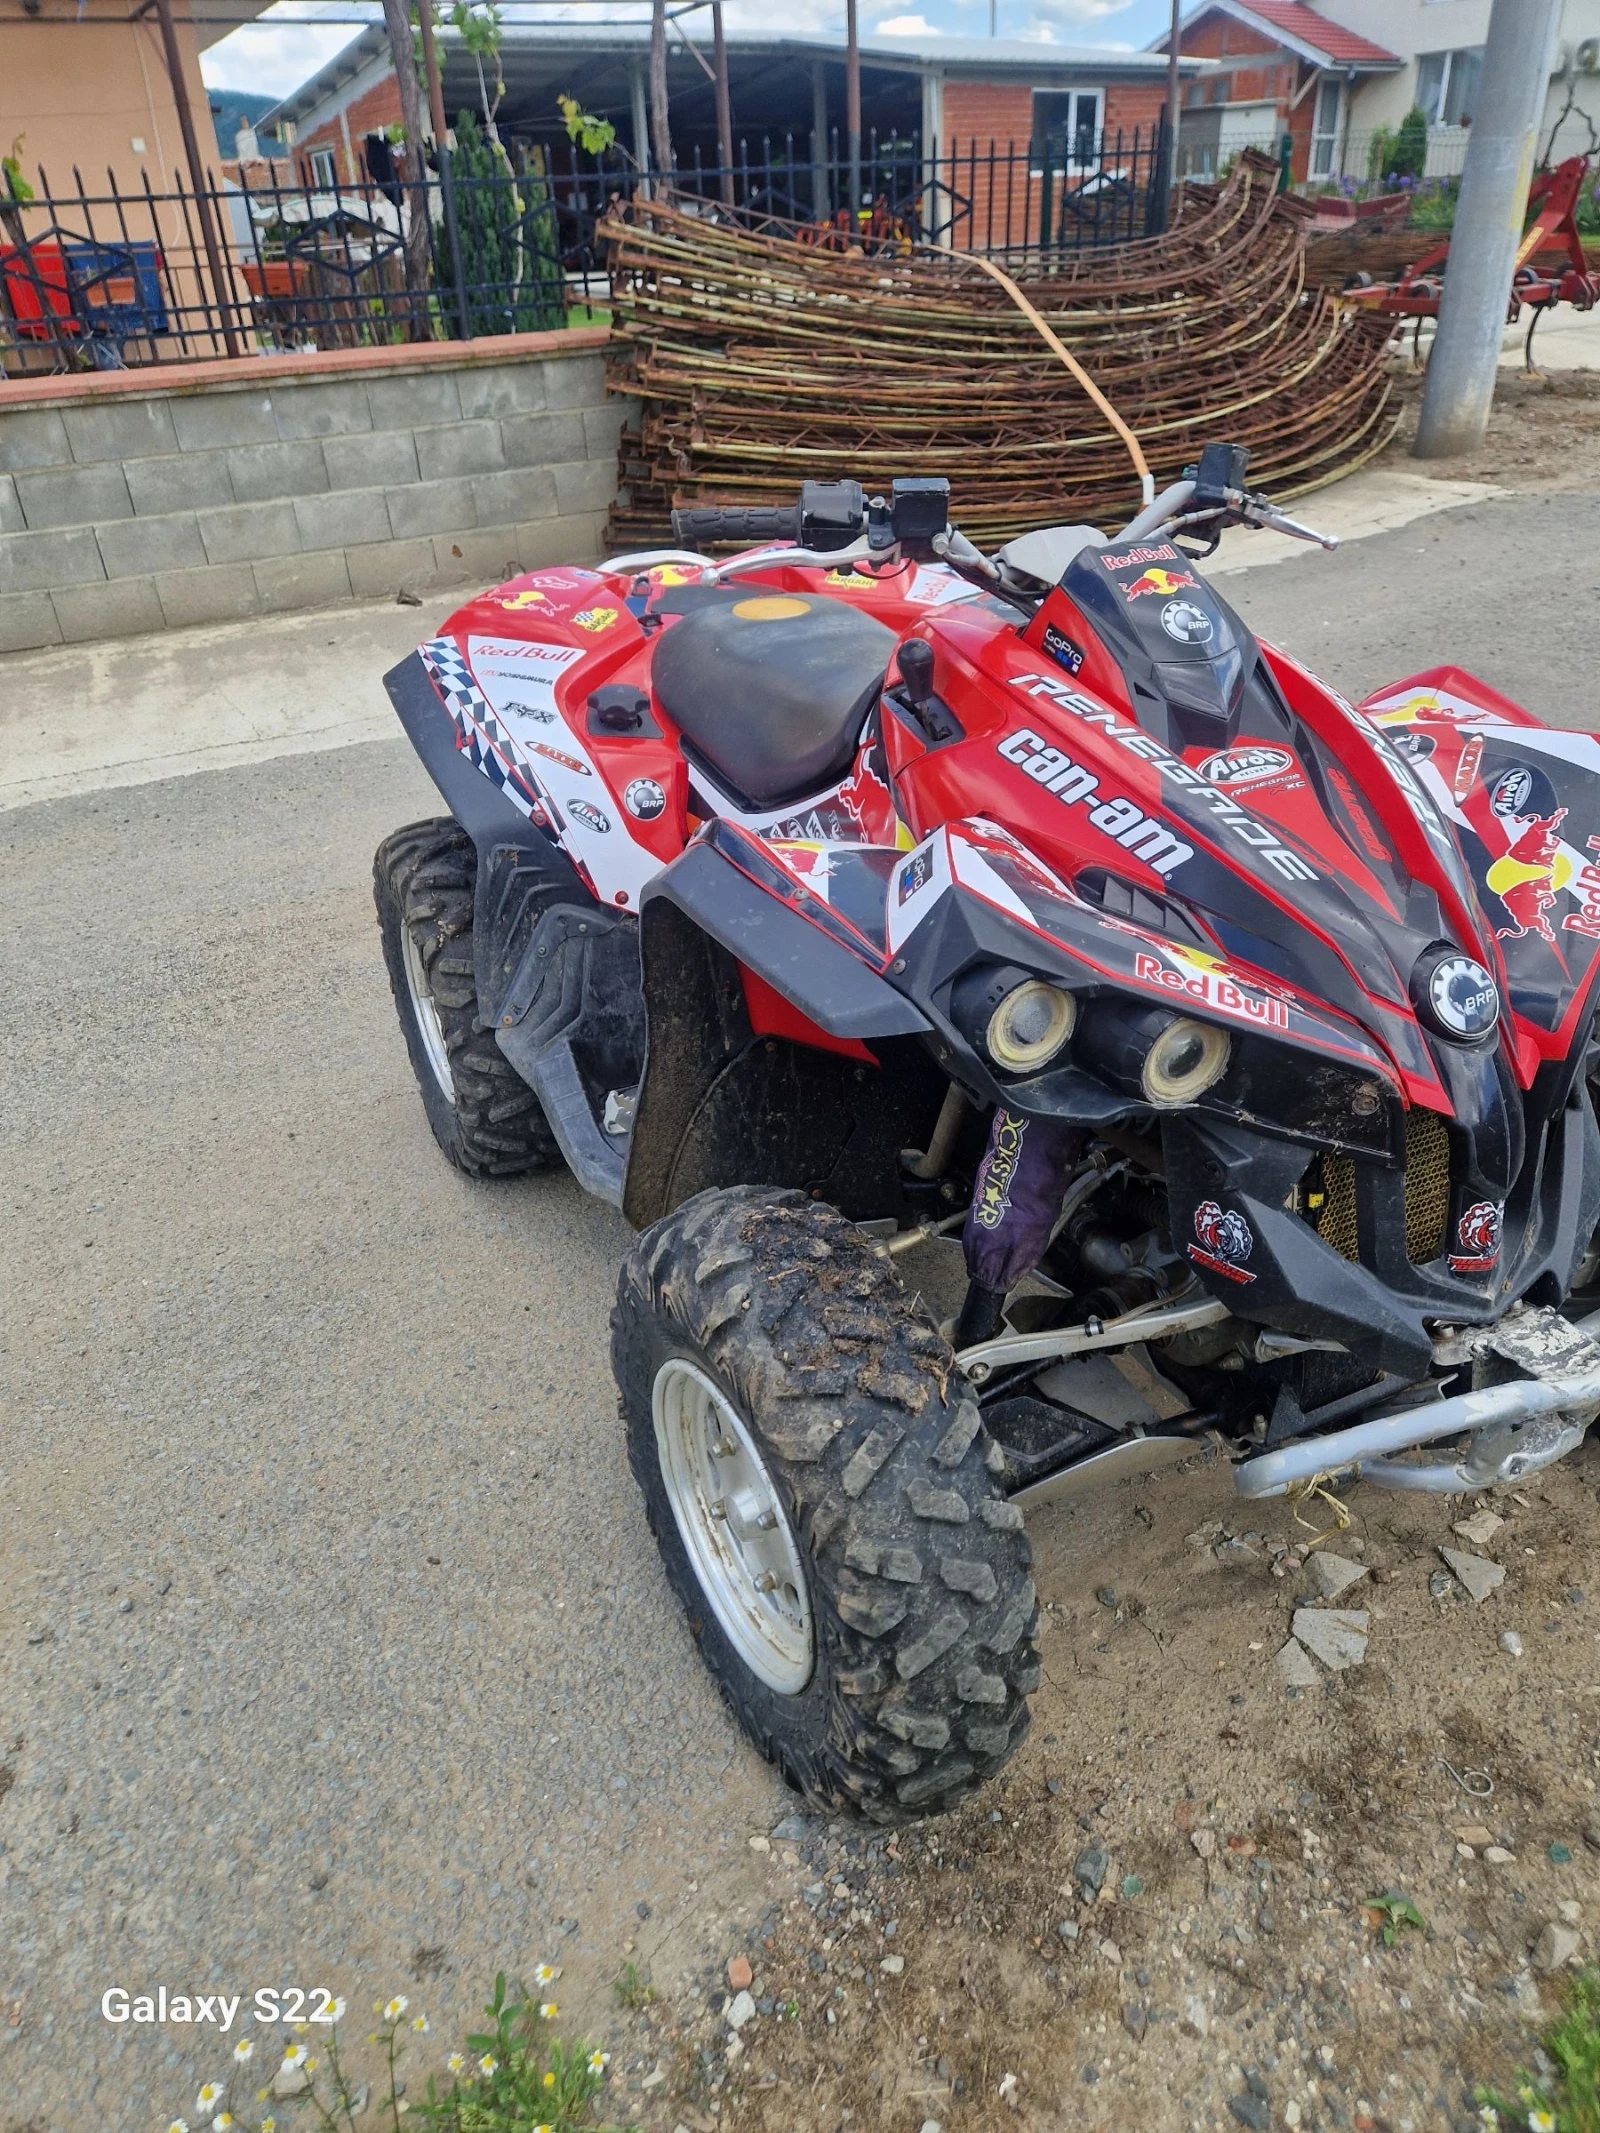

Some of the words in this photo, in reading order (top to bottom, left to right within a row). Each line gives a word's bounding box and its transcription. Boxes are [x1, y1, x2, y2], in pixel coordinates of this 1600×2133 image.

[1100, 548, 1144, 571] Red
[1137, 544, 1178, 562] Bull
[1188, 620, 1210, 630] BRP
[473, 645, 526, 658] Red
[523, 646, 576, 662] Bull
[1045, 628, 1083, 665] GoPro
[535, 743, 583, 772] MAXXIS
[1210, 750, 1287, 780] Airoh
[1455, 741, 1484, 793] MAXXIS
[1008, 674, 1320, 881] RENEGADE
[1495, 770, 1525, 814] Airoh
[570, 800, 607, 832] Airoh
[641, 799, 664, 808] BRP
[997, 728, 1195, 875] can-am
[1135, 953, 1210, 1001] Red
[1216, 980, 1289, 1029] Bull
[1465, 988, 1495, 1010] BRP
